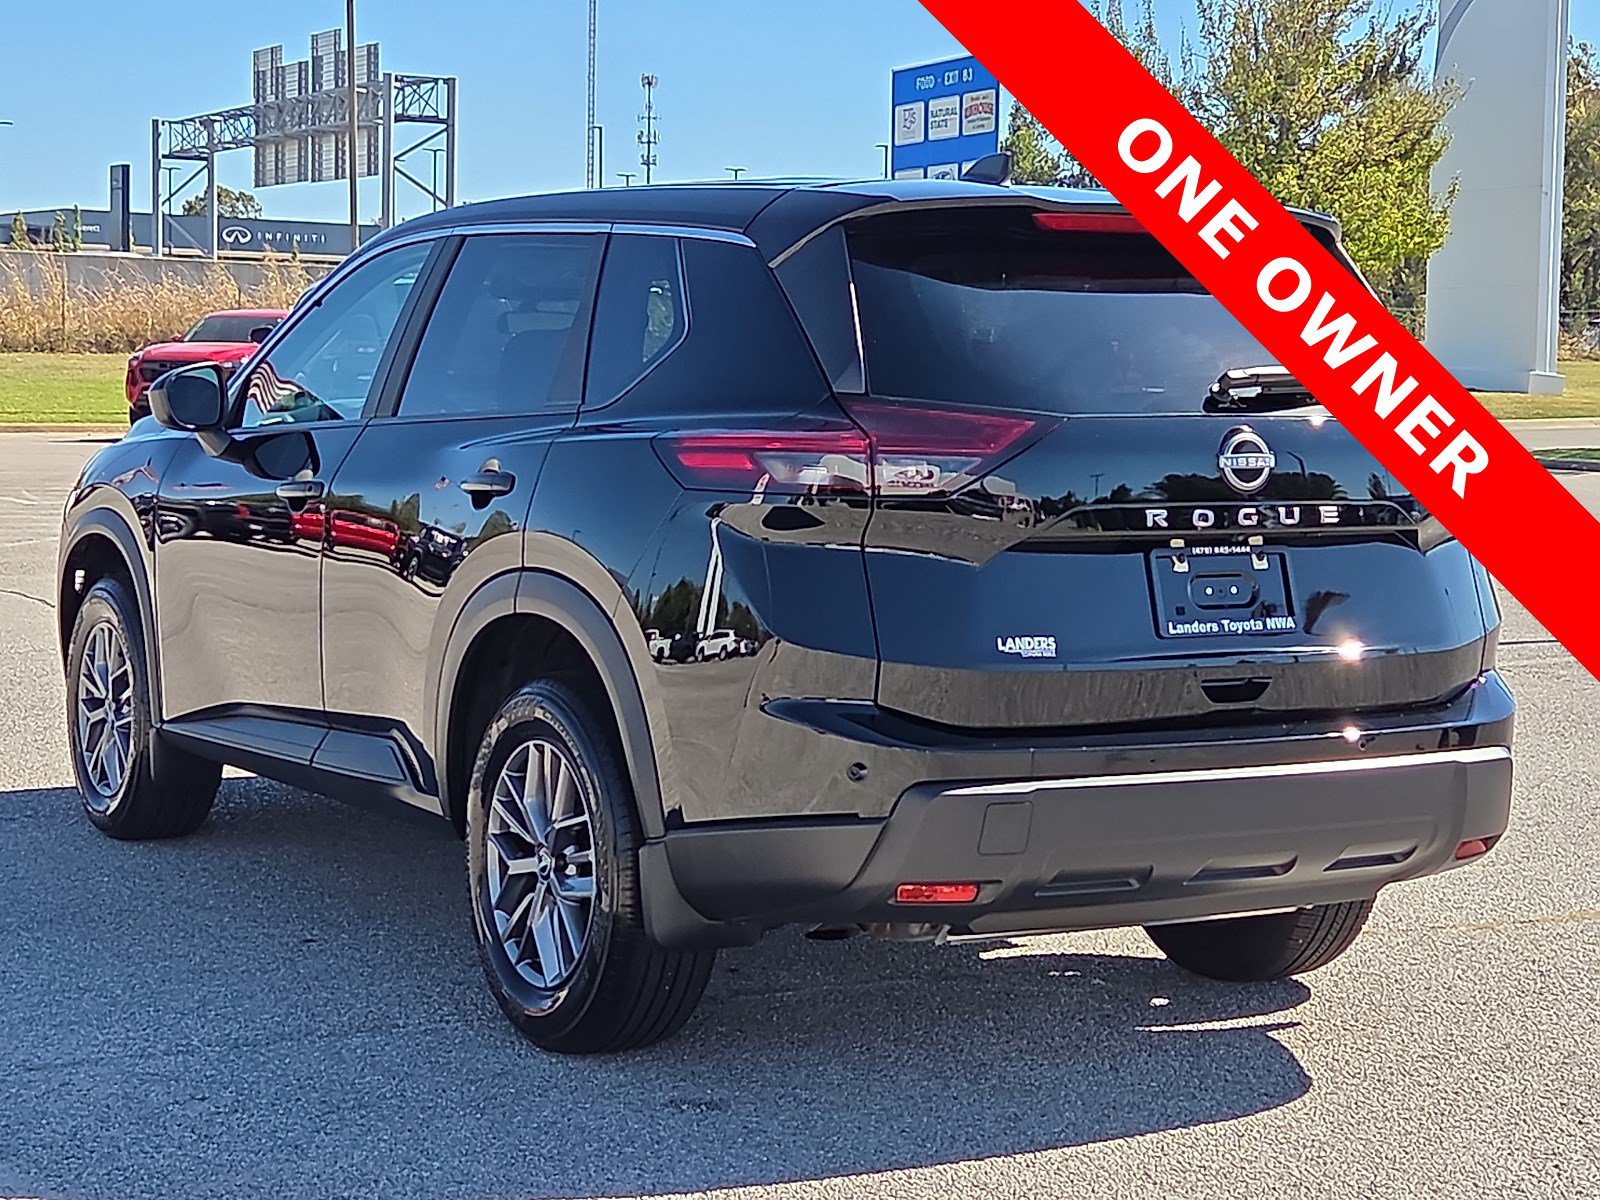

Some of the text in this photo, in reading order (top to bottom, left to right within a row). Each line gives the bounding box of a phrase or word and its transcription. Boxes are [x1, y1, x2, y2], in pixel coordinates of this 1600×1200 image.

[916, 75, 935, 90] FOOD
[944, 70, 959, 85] EXIT
[930, 106, 958, 118] NATURAL
[930, 118, 948, 130] STATE
[257, 231, 325, 243] INFINITI
[1221, 457, 1271, 467] NISSAN
[1145, 506, 1339, 527] ROGUE
[1168, 616, 1295, 634] Landers Toyota NWA
[997, 636, 1057, 652] LANDERS
